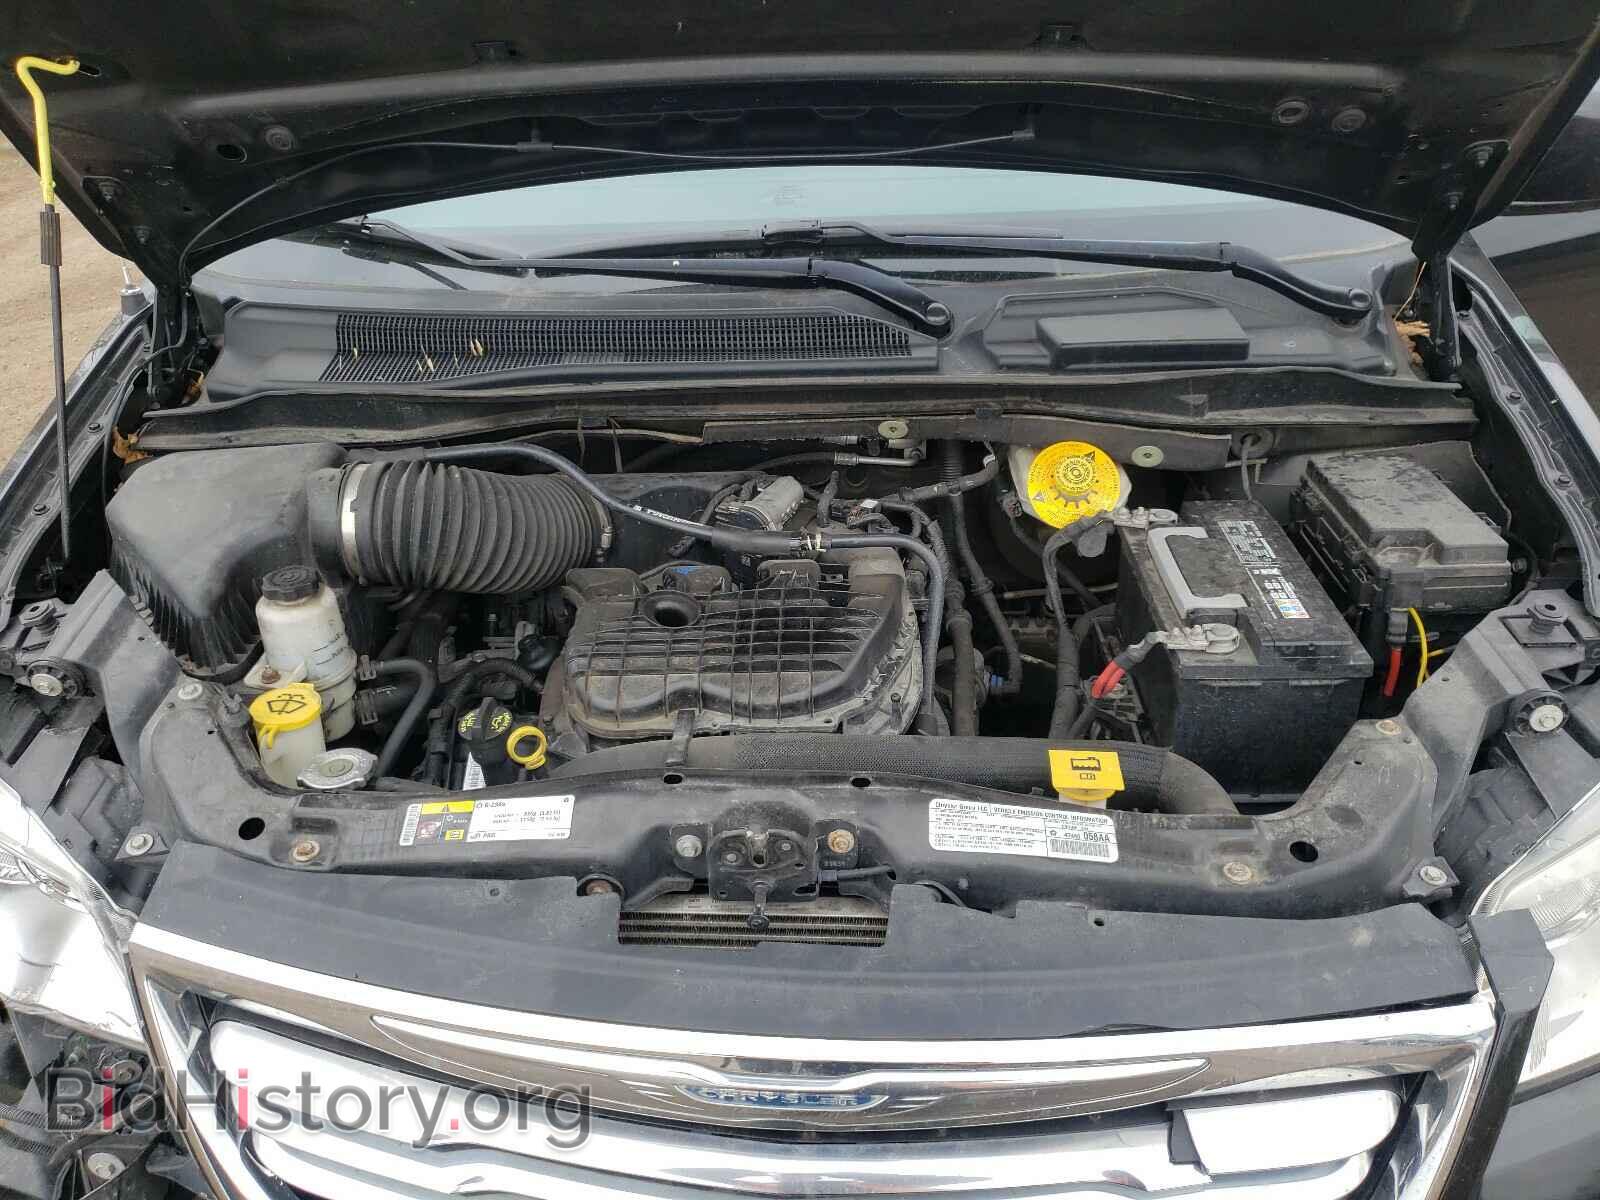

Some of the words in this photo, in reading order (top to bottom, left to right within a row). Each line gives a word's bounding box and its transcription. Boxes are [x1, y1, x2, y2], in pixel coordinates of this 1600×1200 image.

[993, 807, 1016, 815] VEHICLE
[1017, 809, 1043, 818] EMISSION
[1070, 815, 1108, 825] INFORMATION
[700, 1087, 857, 1105] CHRYSLER
